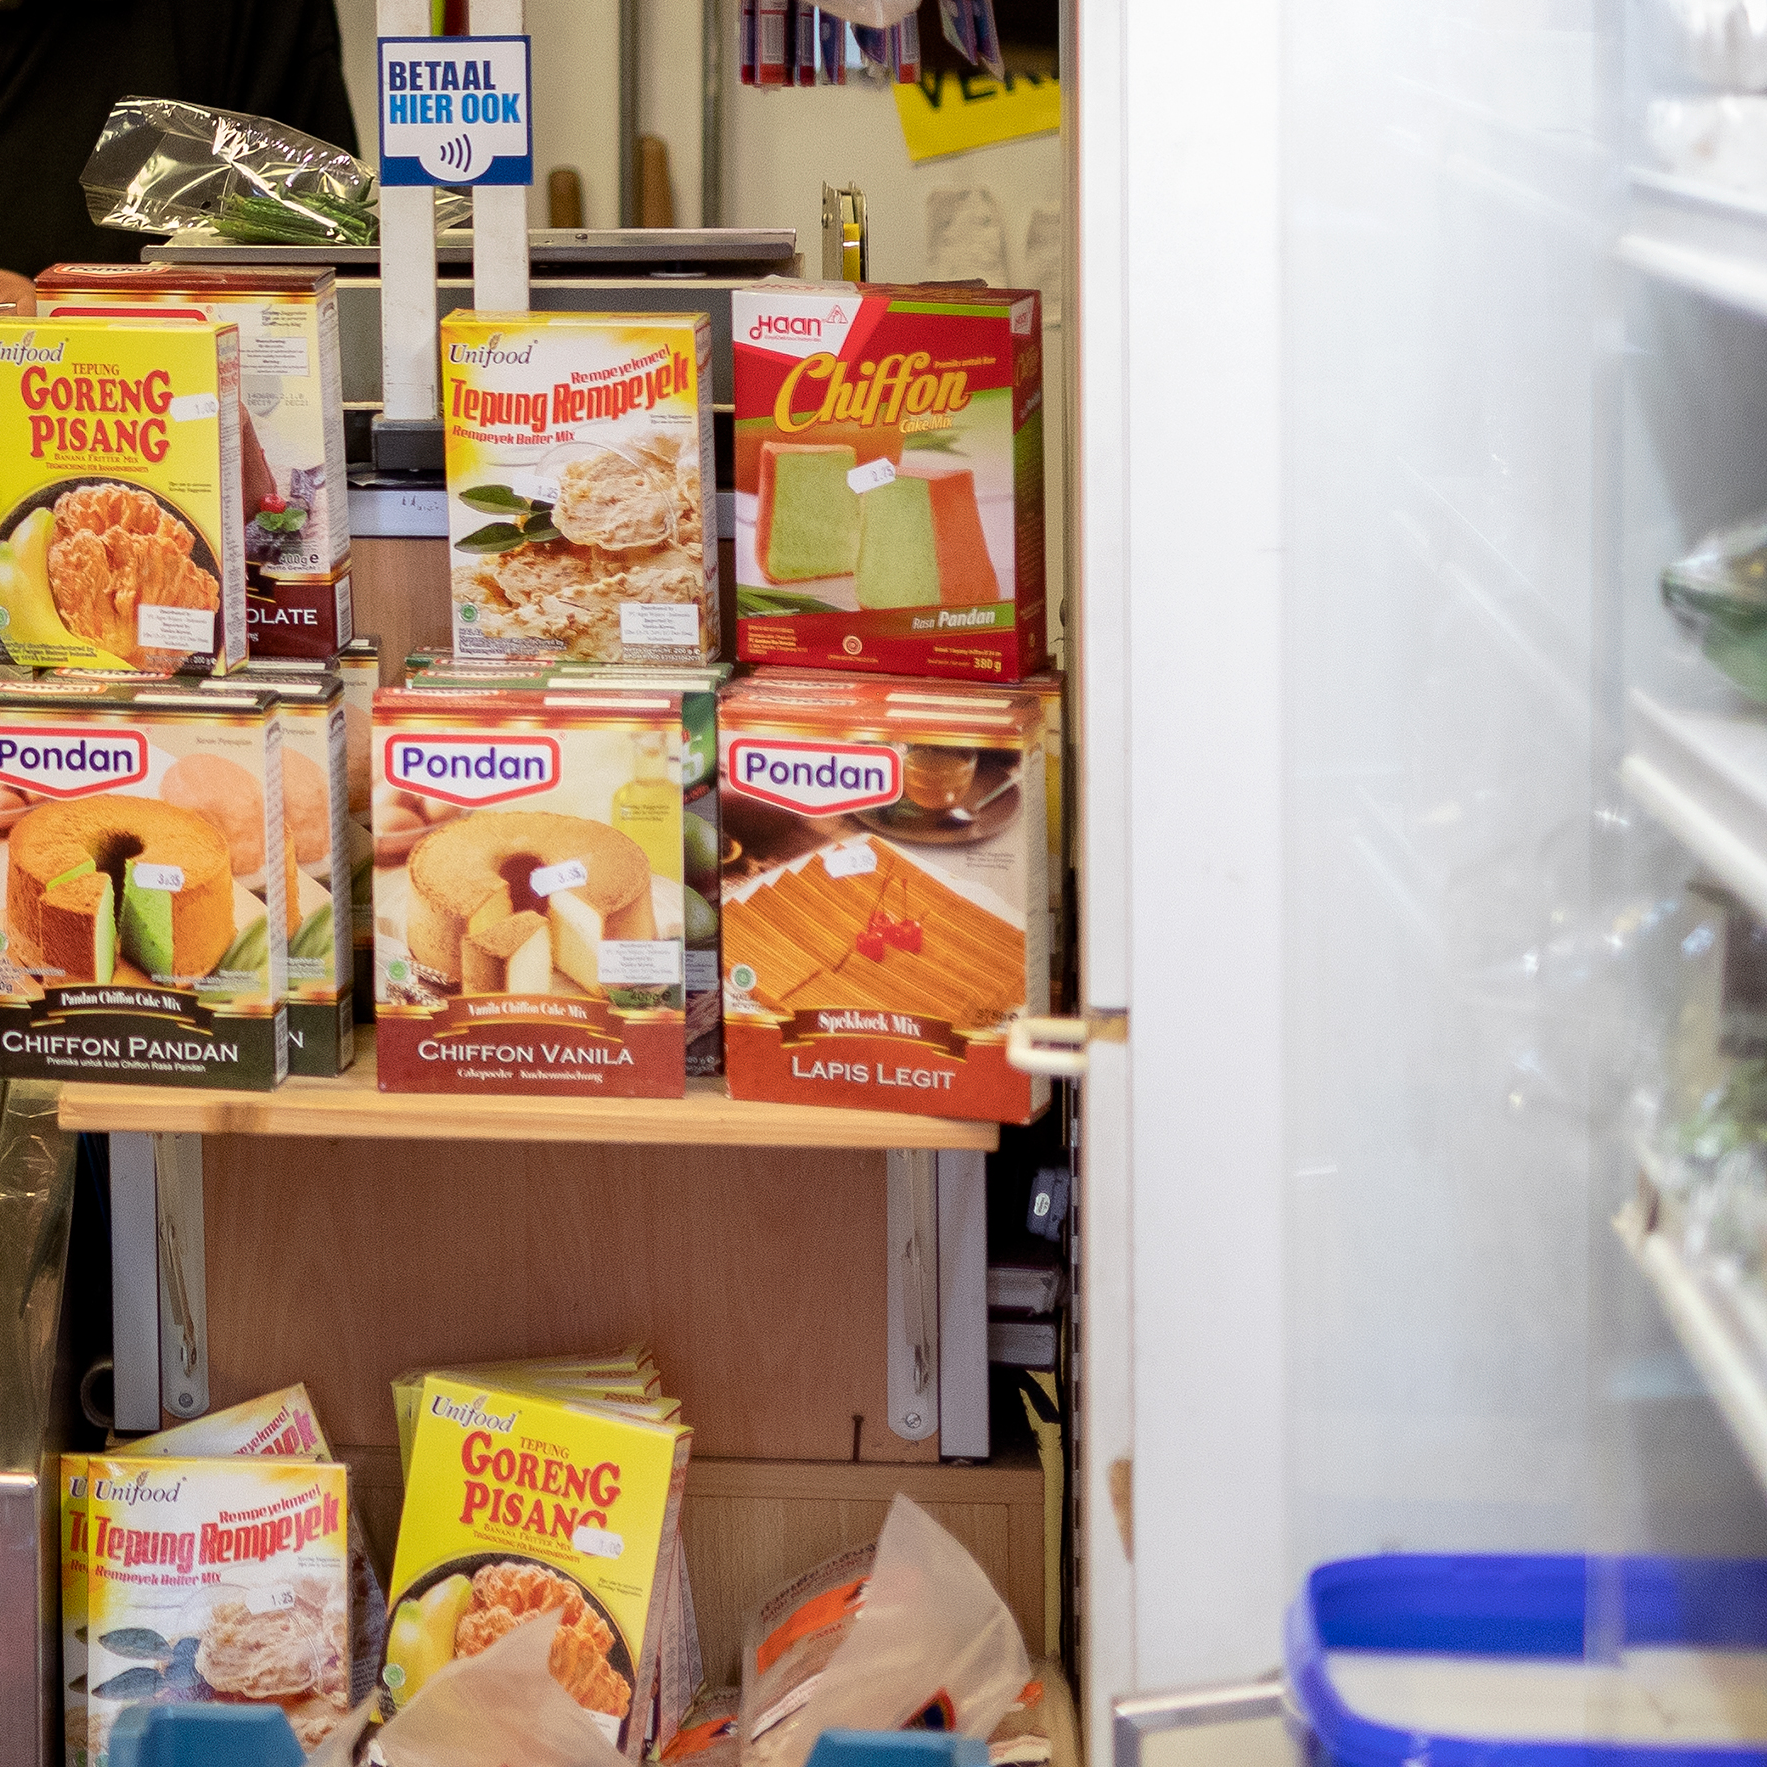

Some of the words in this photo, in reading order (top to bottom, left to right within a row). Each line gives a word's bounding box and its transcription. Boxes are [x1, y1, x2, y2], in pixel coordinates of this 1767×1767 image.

[389, 61, 496, 91] BETAAL
[389, 94, 453, 124] HIER
[461, 93, 521, 124] OOK
[71, 363, 120, 376] TEPUNG
[449, 343, 533, 368] Unifood
[570, 344, 671, 384] Rempeyekmeel
[21, 365, 174, 415] GORENG
[450, 378, 548, 433] Tepung
[552, 351, 689, 425] Rempeyek
[773, 351, 973, 434] Chiffon
[29, 415, 171, 463] PISANG
[452, 425, 514, 445] Rempeyek
[517, 433, 554, 445] Batter
[556, 430, 575, 442] Mix
[899, 419, 928, 434] Cake
[929, 414, 953, 430] Mix
[54, 453, 86, 463] BANANA
[88, 454, 121, 463] FRITTER
[123, 455, 139, 464] MIX
[911, 617, 935, 630] Rasa
[937, 609, 996, 628] Pandan
[402, 746, 545, 780] Pondan
[746, 752, 886, 792] Pondan
[61, 992, 98, 1007] Pandan
[99, 991, 134, 1006] Chiffon
[135, 992, 161, 1009] Cake
[162, 996, 182, 1012] Mix
[468, 1003, 500, 1017] Vanila
[501, 1001, 538, 1015] Chiffon
[539, 1003, 566, 1017] Cake
[568, 1005, 588, 1020] Mix
[891, 1015, 921, 1037] Mix
[2, 1031, 119, 1057] CHIFFON
[128, 1037, 239, 1062] PANDAN
[418, 1040, 534, 1063] CHIFFON
[540, 1044, 634, 1066] VANILA
[792, 1056, 869, 1083] LAPIS
[876, 1063, 955, 1089] LEGIT
[431, 1395, 516, 1433] Unifood
[520, 1436, 570, 1459] TEPUNG
[461, 1430, 621, 1508] GORENG
[95, 1480, 182, 1506] Unifood
[219, 1484, 322, 1524] Rempeyekmeel
[95, 1516, 195, 1573] Tepung
[198, 1492, 339, 1566] Rempeyek
[95, 1565, 158, 1585] Rempeyek
[201, 1572, 221, 1584] Mix
[271, 1592, 293, 1606] 1.25
